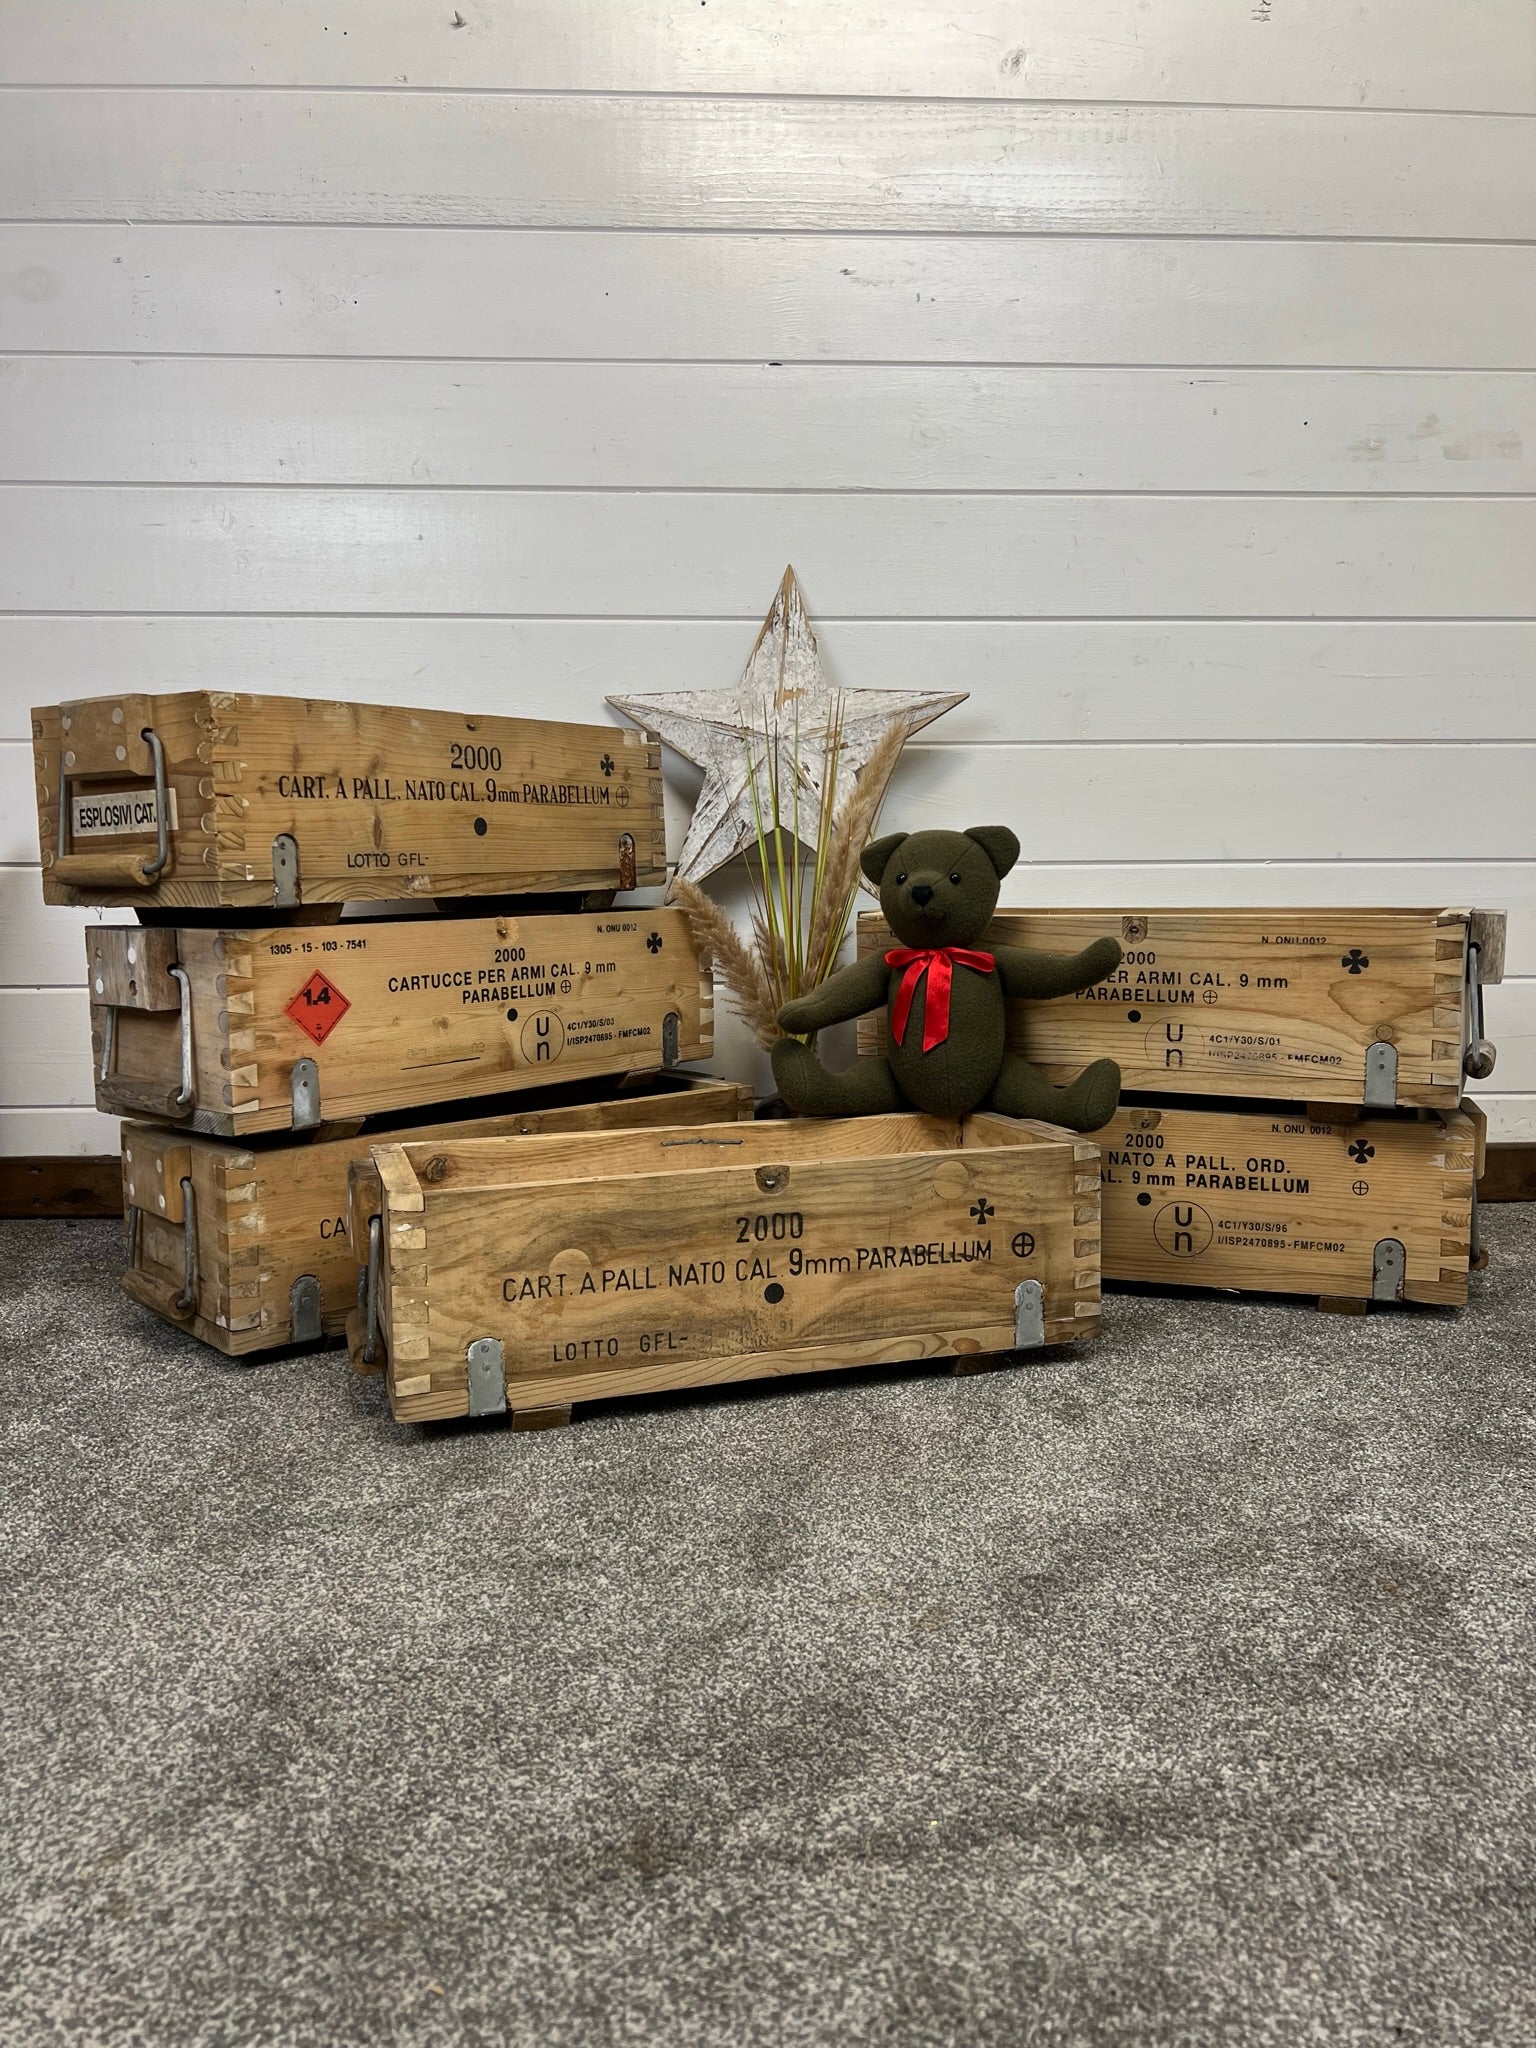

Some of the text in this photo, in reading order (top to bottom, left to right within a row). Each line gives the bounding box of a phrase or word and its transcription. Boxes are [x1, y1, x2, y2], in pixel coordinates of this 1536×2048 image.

[450, 743, 502, 771] 2000
[278, 775, 610, 806] CART. A PALL. NATO CAL. 9mm PARABELLUM
[79, 804, 133, 828] ESPLOSIVI
[134, 801, 157, 825] CAT.
[347, 853, 390, 868] LOTTO
[606, 924, 621, 933] ONU
[622, 923, 637, 932] 0012
[269, 944, 292, 955] 1305
[301, 942, 313, 953] 15
[321, 941, 338, 951] 103
[346, 939, 367, 950] 7541
[494, 947, 526, 963] 2000
[388, 961, 616, 993] CARTUCCE PER ARMI CAL. 9 mm
[1106, 970, 1289, 989] ER ARMI CAL. 9 mm
[462, 981, 556, 1005] PARABELLUM
[1075, 986, 1195, 1004] PARABELLUM
[1125, 1133, 1165, 1149] 2000
[1271, 1123, 1333, 1136] N. ONU 0012
[1108, 1151, 1292, 1174] NATO A PALL. ORD.
[1132, 1170, 1141, 1185] 9
[1146, 1173, 1176, 1187] mm
[1185, 1173, 1310, 1195] PARABELLUM
[735, 1211, 804, 1243] 2000
[1217, 1219, 1288, 1233] 4C1/Y30/S/96
[502, 1238, 992, 1303] CART. A PALL. NATO CAL. 9mm PARABELLUM
[553, 1337, 619, 1363] LOTTO
[639, 1331, 688, 1353] GFL-
